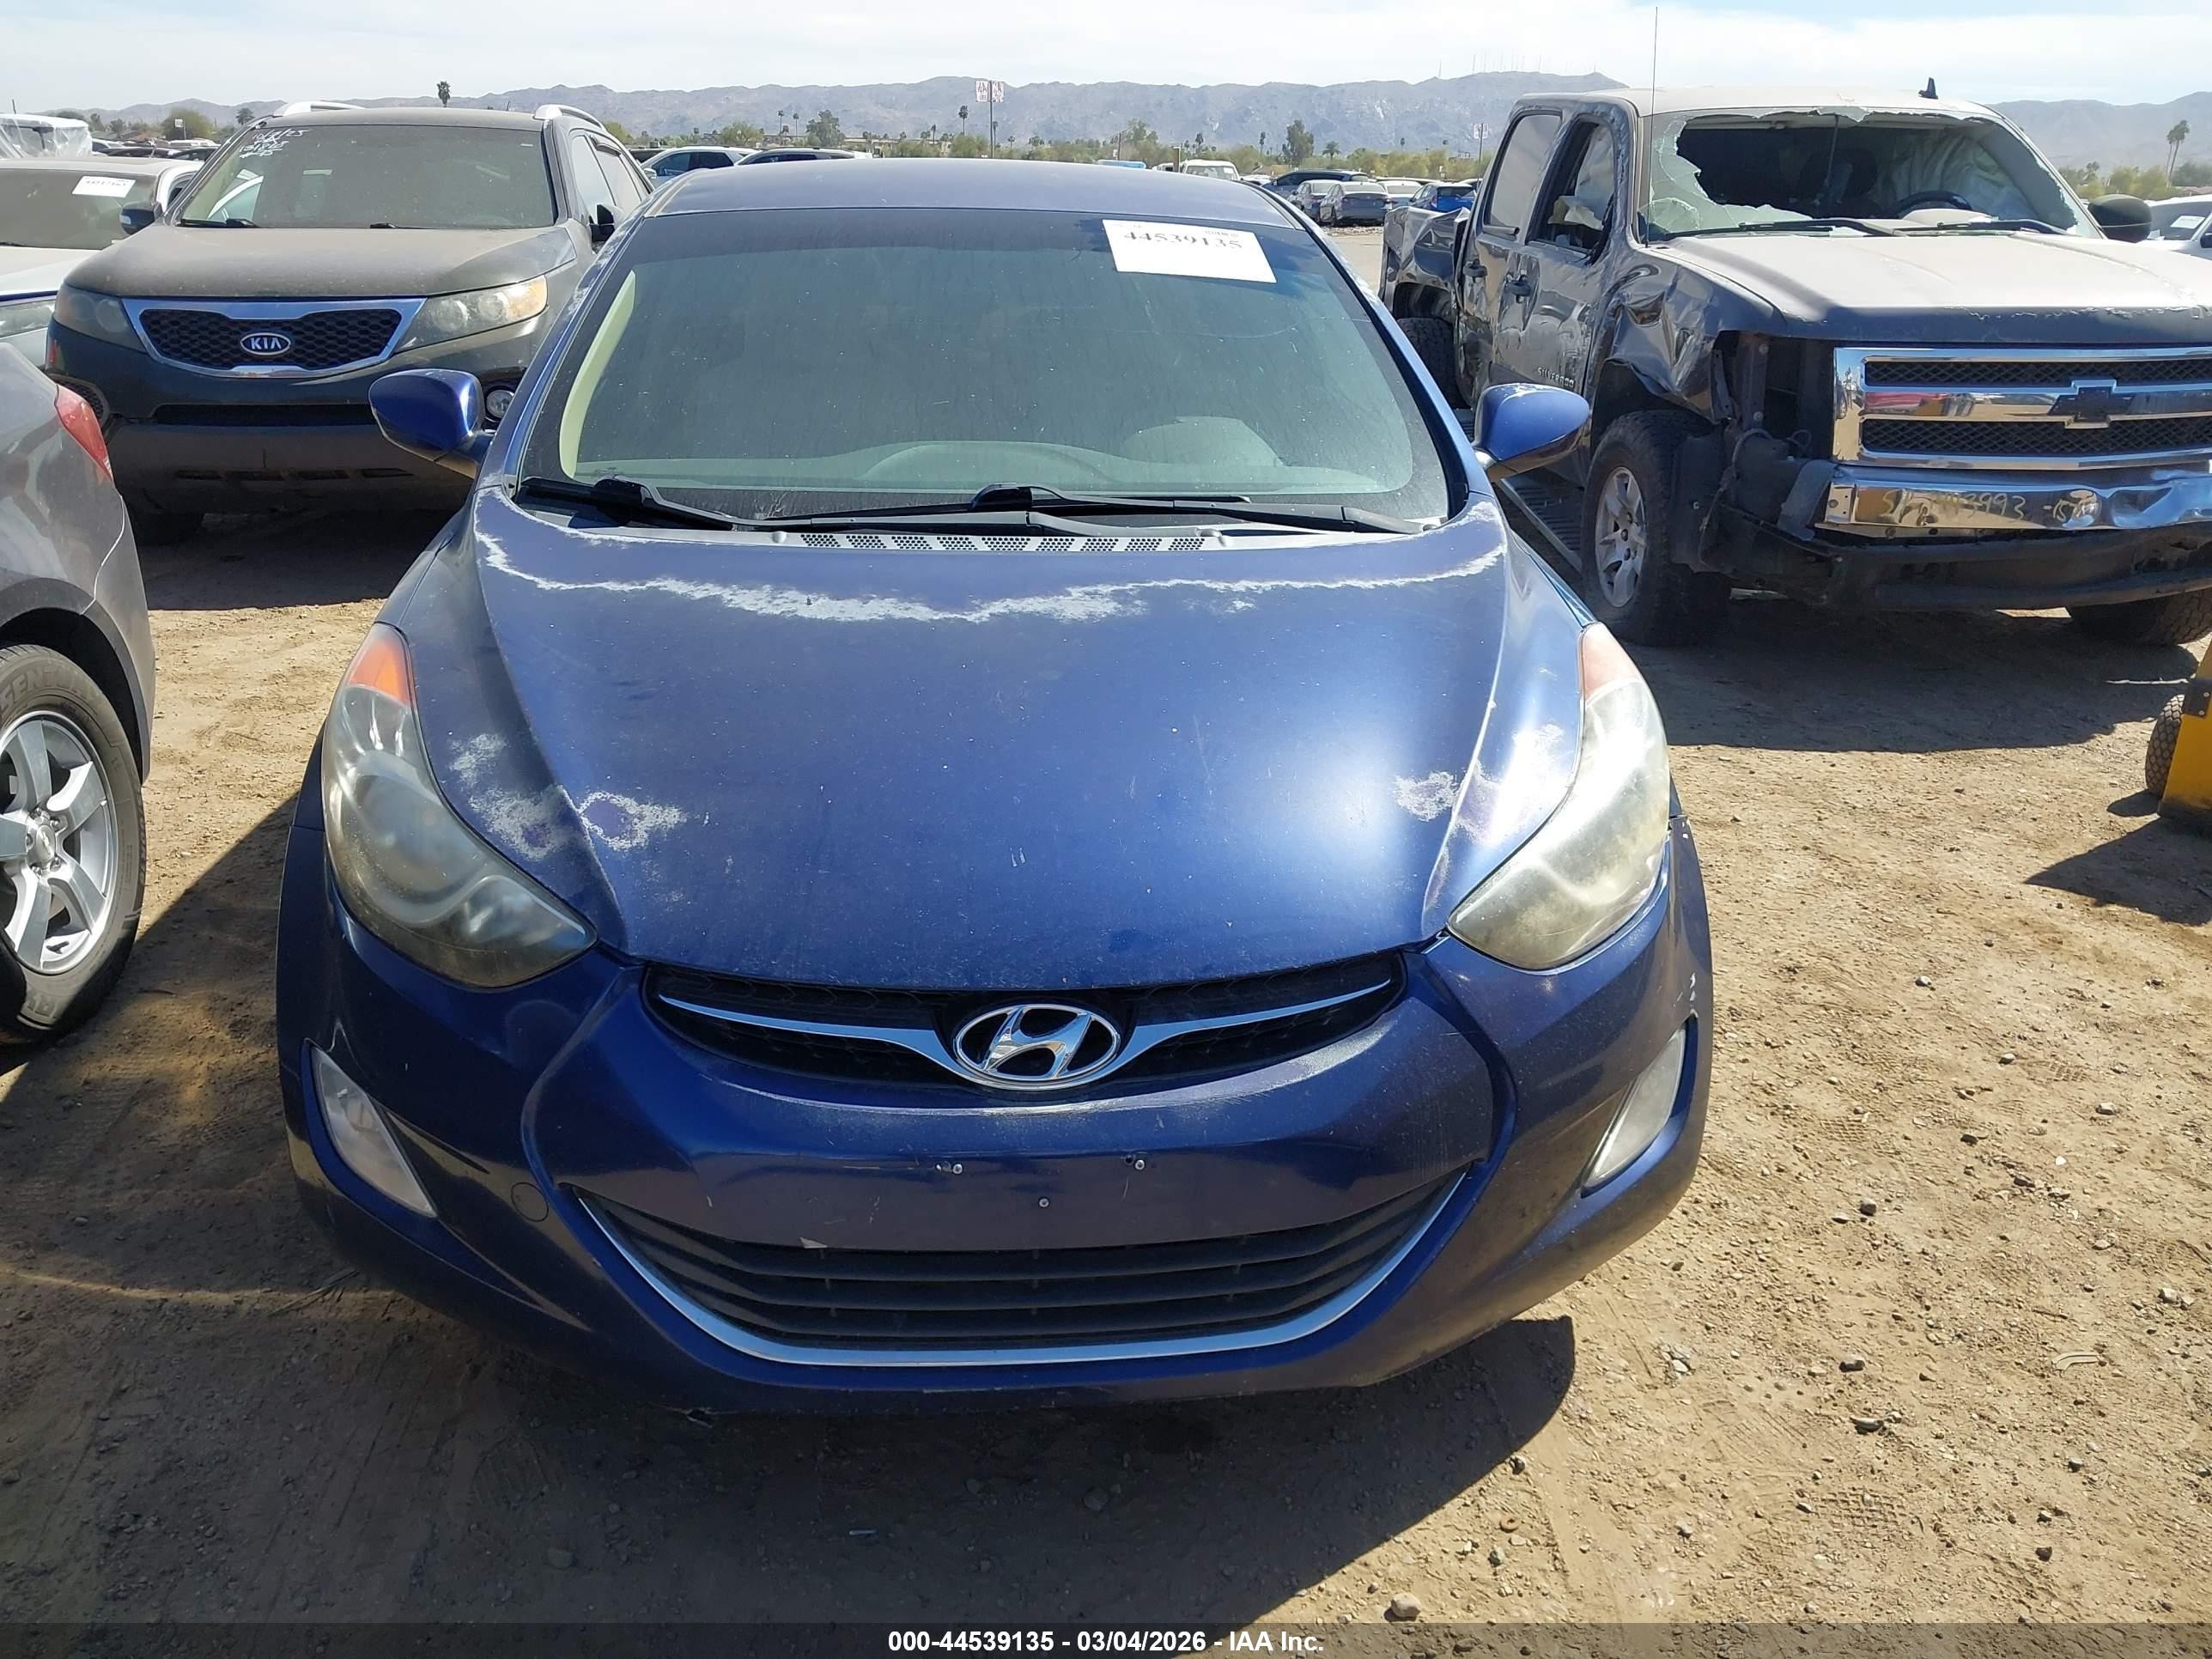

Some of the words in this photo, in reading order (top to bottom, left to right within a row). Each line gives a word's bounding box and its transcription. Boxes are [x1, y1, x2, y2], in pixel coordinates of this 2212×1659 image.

[1123, 231, 1243, 249] 44539135
[250, 337, 282, 349] KIA
[1537, 367, 1575, 388] SILVERADO
